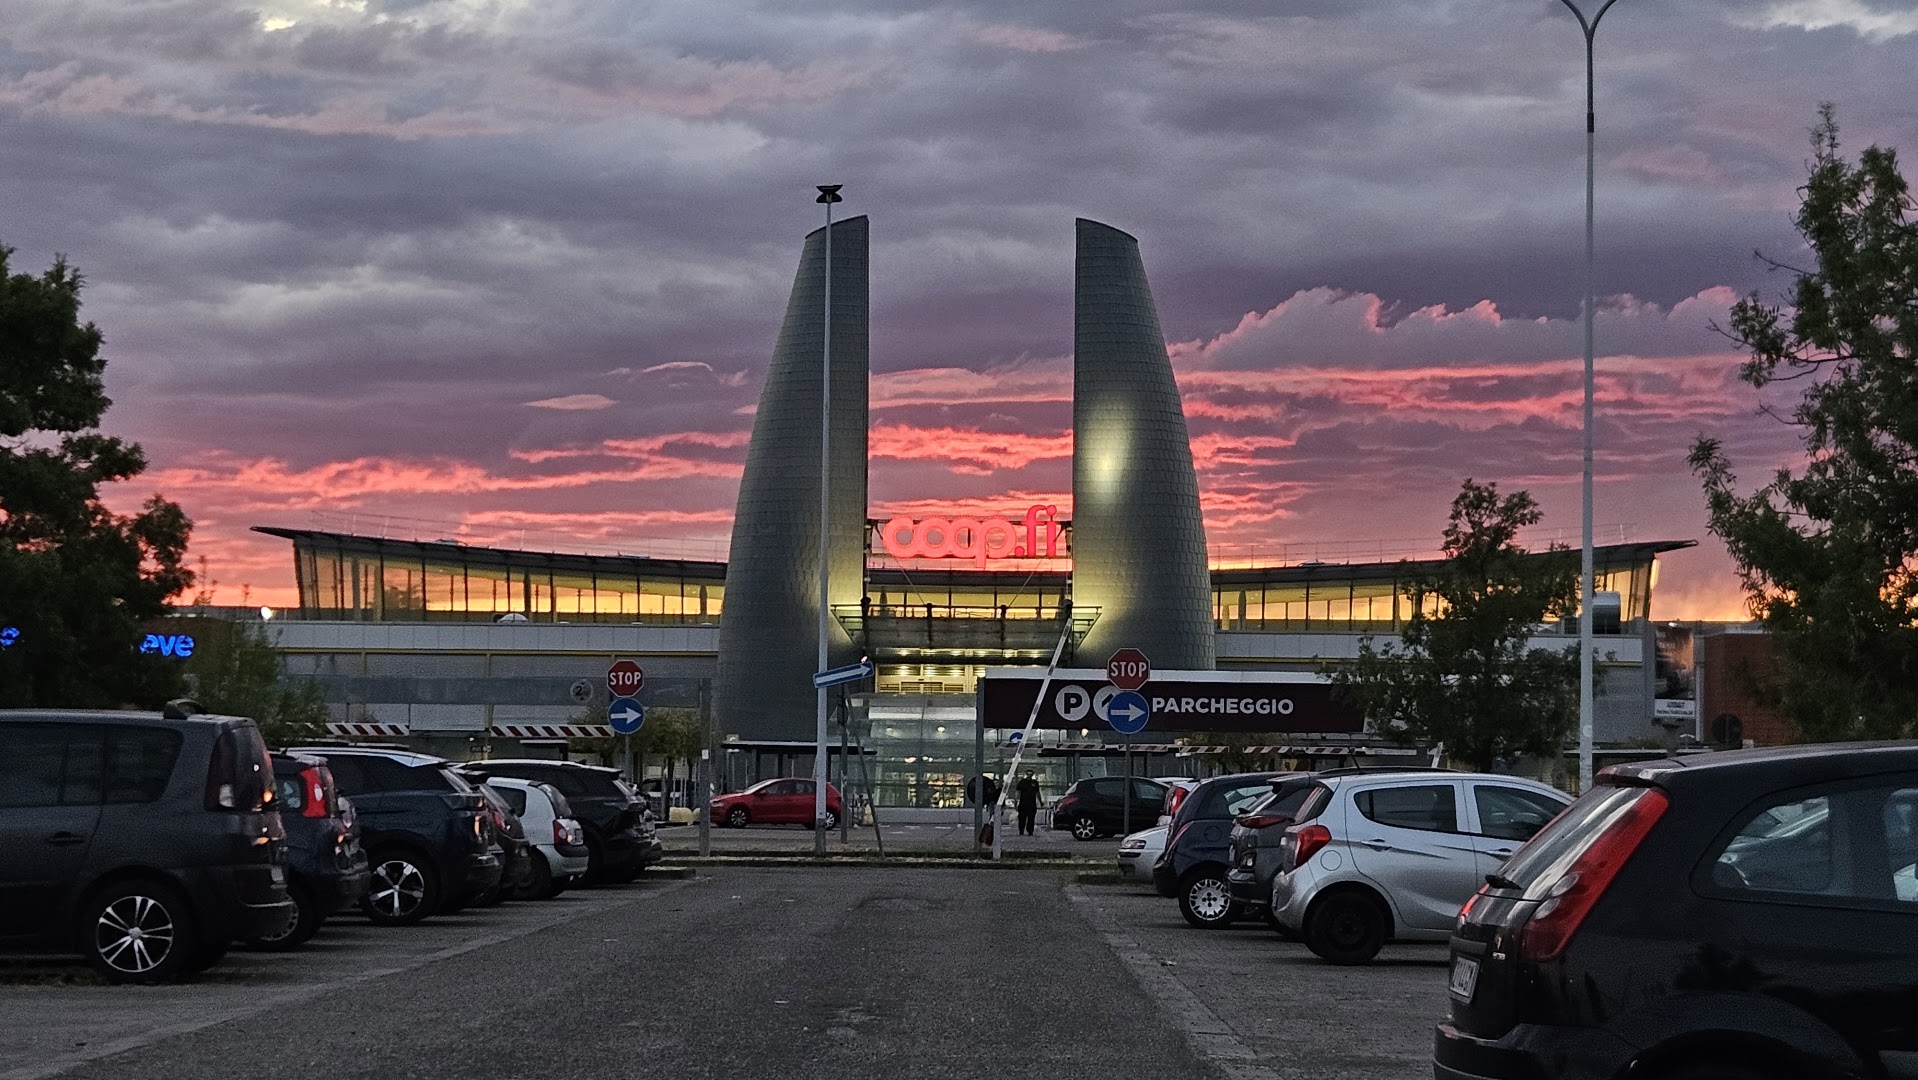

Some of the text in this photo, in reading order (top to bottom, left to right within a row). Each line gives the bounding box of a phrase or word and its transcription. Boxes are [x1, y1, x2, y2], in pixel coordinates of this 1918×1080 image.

[882, 504, 1058, 568] coop.fi
[139, 633, 195, 657] eve
[609, 671, 642, 686] STOP
[1110, 661, 1147, 678] STOP
[1063, 692, 1294, 715] P PARCHEGGIO
